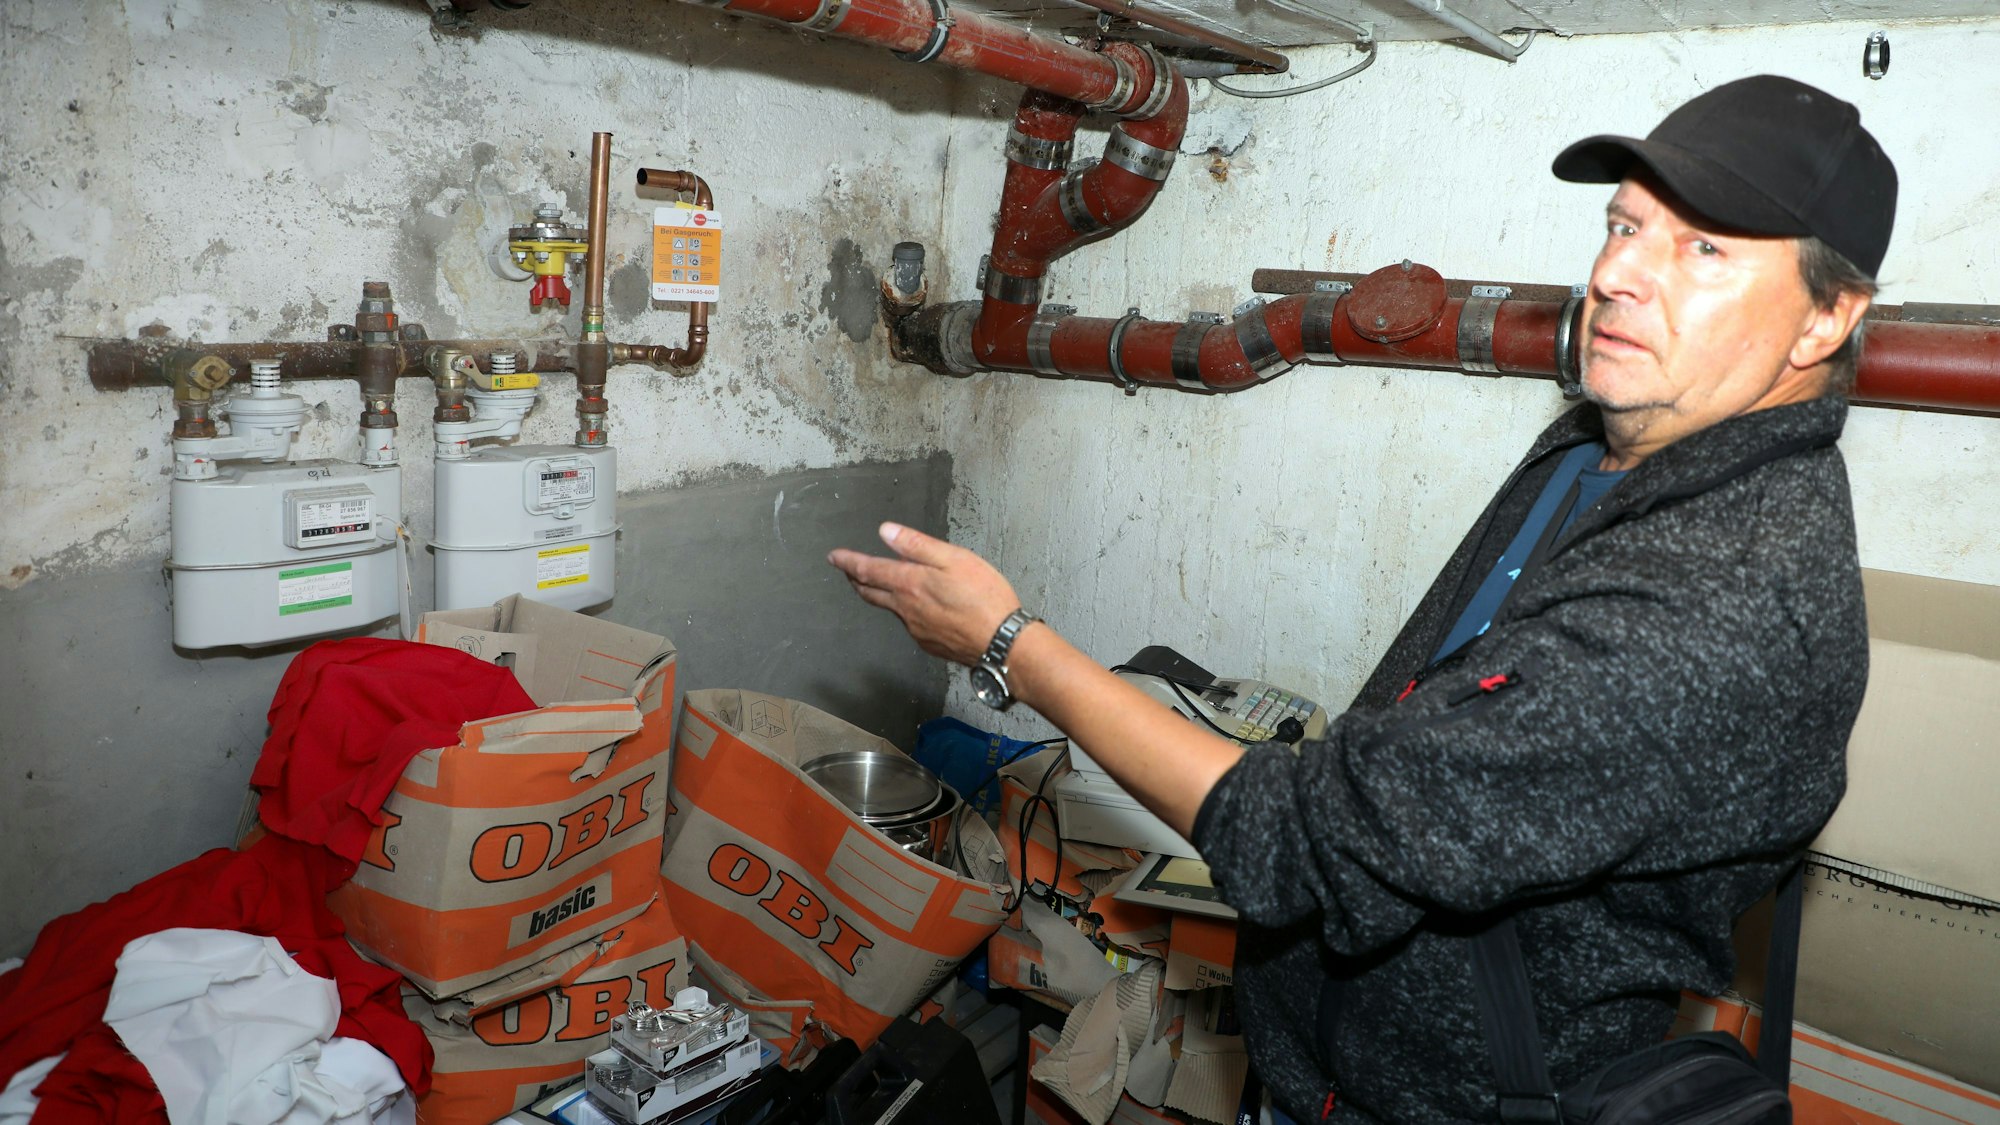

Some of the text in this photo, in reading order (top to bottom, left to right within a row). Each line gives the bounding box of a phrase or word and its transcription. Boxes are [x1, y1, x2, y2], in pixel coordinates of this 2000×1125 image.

[673, 228, 713, 237] Gasgeruch:
[469, 772, 655, 883] OBI
[527, 884, 596, 939] basic
[708, 843, 875, 977] OBI
[1804, 886, 2000, 939] SCHE BIERKULTU
[472, 958, 676, 1046] OBI
[1209, 968, 1232, 984] Wohn
